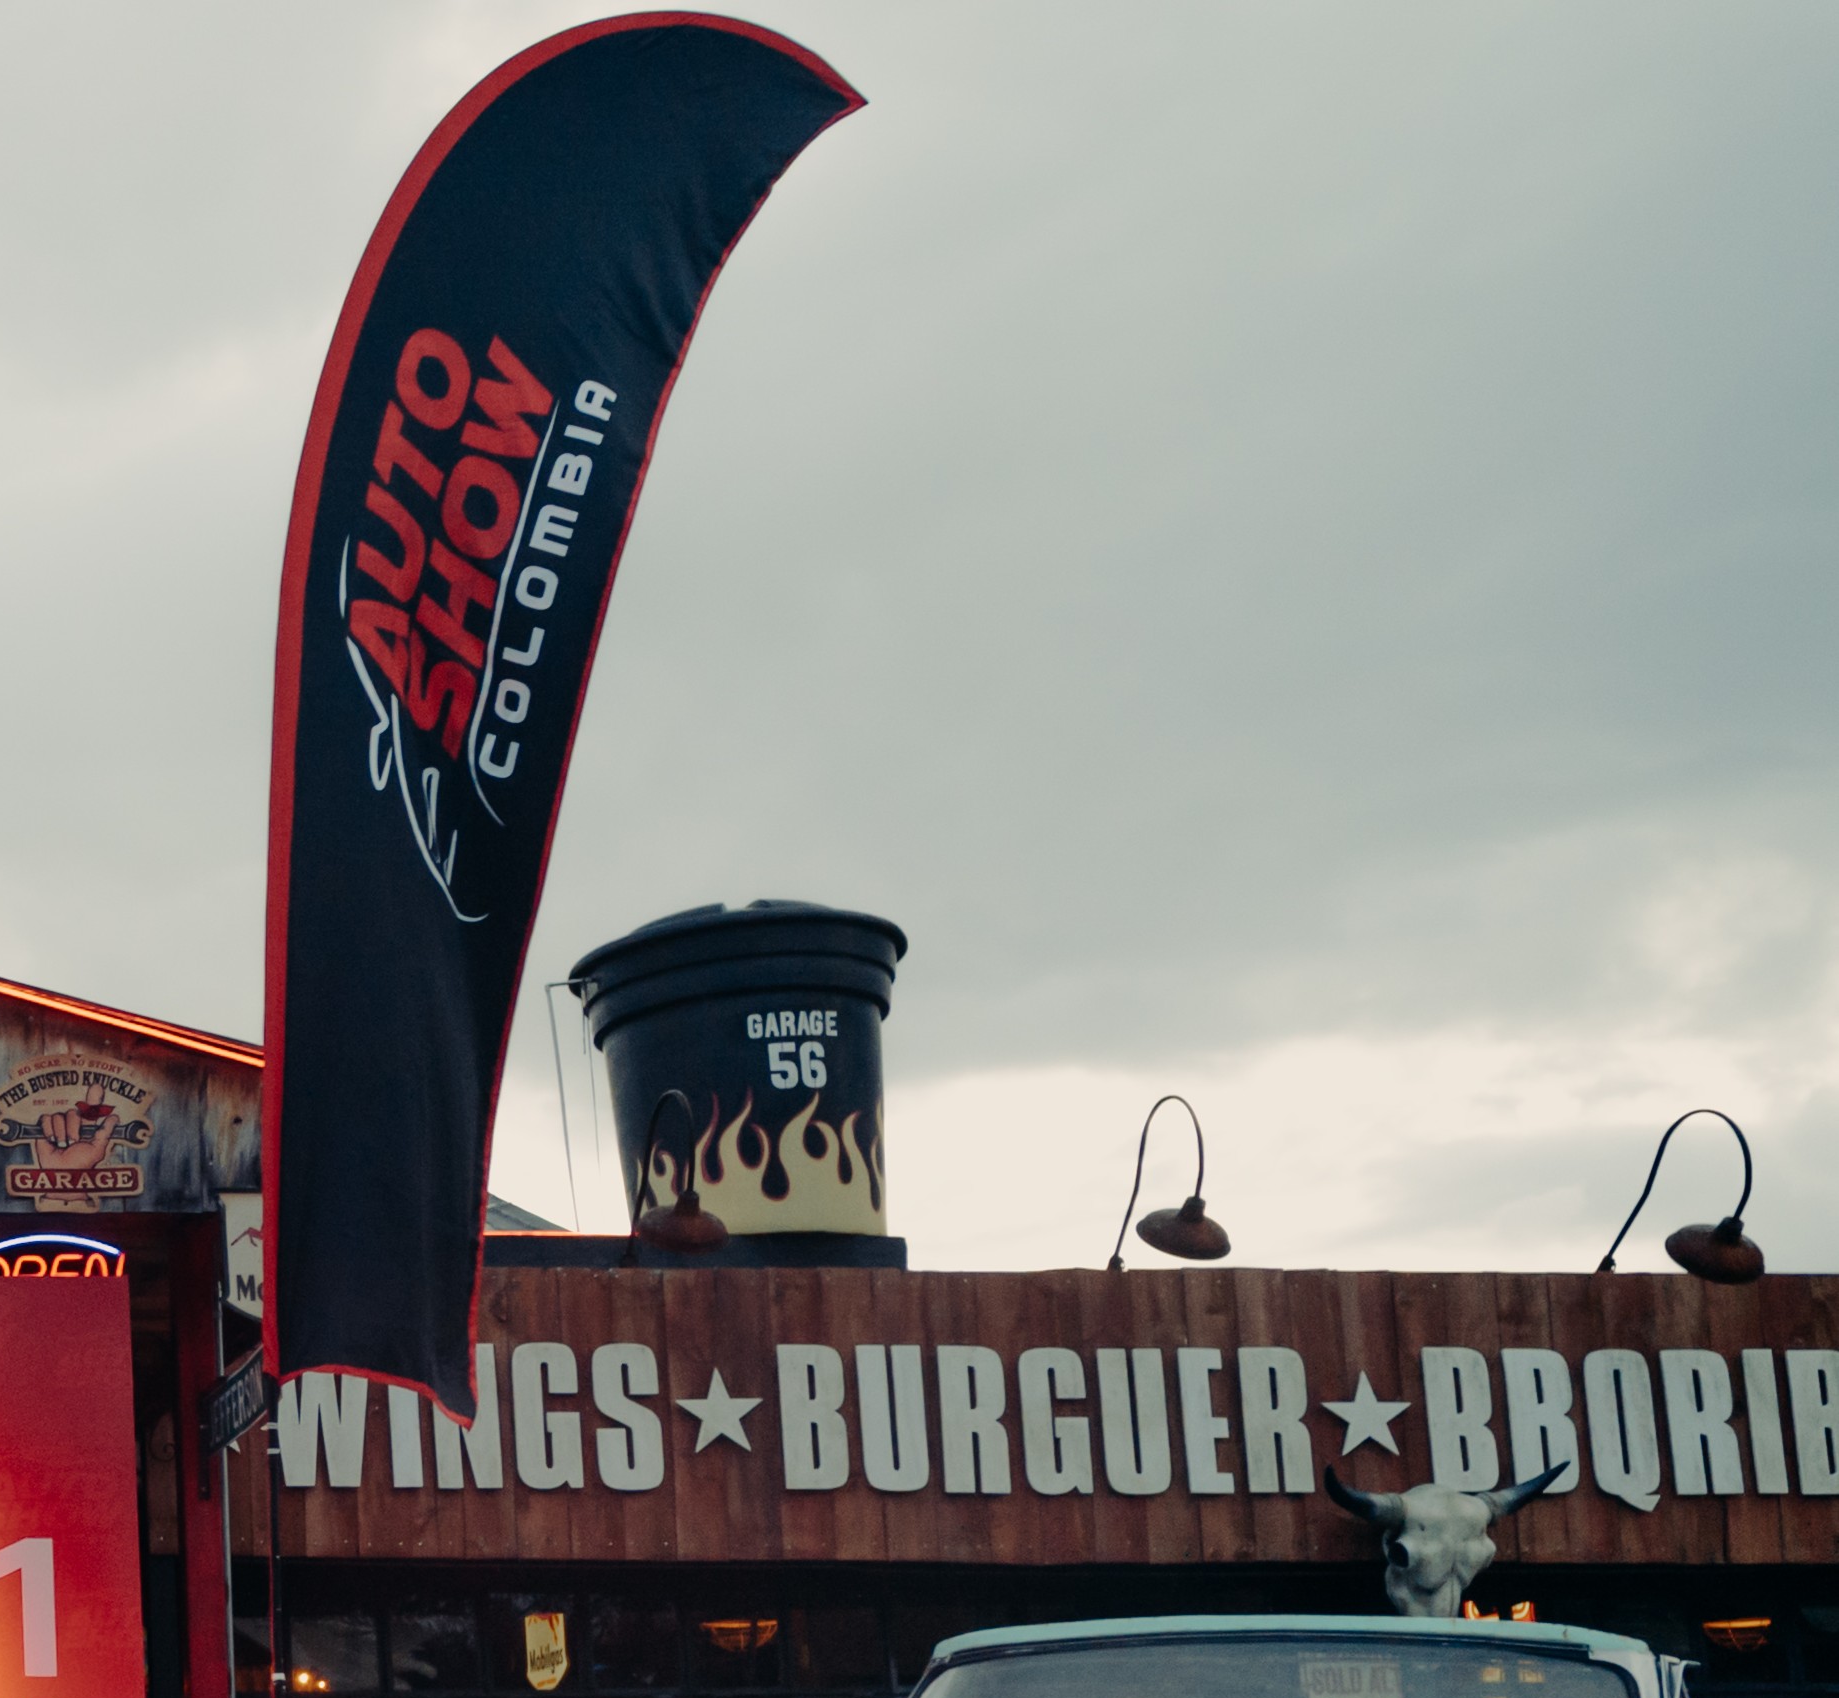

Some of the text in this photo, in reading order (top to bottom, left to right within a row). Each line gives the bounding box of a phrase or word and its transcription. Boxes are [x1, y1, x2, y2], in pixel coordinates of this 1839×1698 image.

[349, 328, 471, 696] AUTO
[409, 335, 554, 760] SHOW
[479, 380, 617, 778] COLOMBIA
[747, 1010, 838, 1039] GARAGE
[88, 1059, 123, 1075] STORY
[767, 1041, 827, 1089] 56
[27, 1070, 80, 1094] BUSTED
[82, 1070, 147, 1104] KNUCKLE
[14, 1170, 134, 1190] GARAGE
[278, 1342, 665, 1491] WINGS
[776, 1343, 1316, 1496] BURGUER
[529, 1645, 564, 1674] Mobilgas
